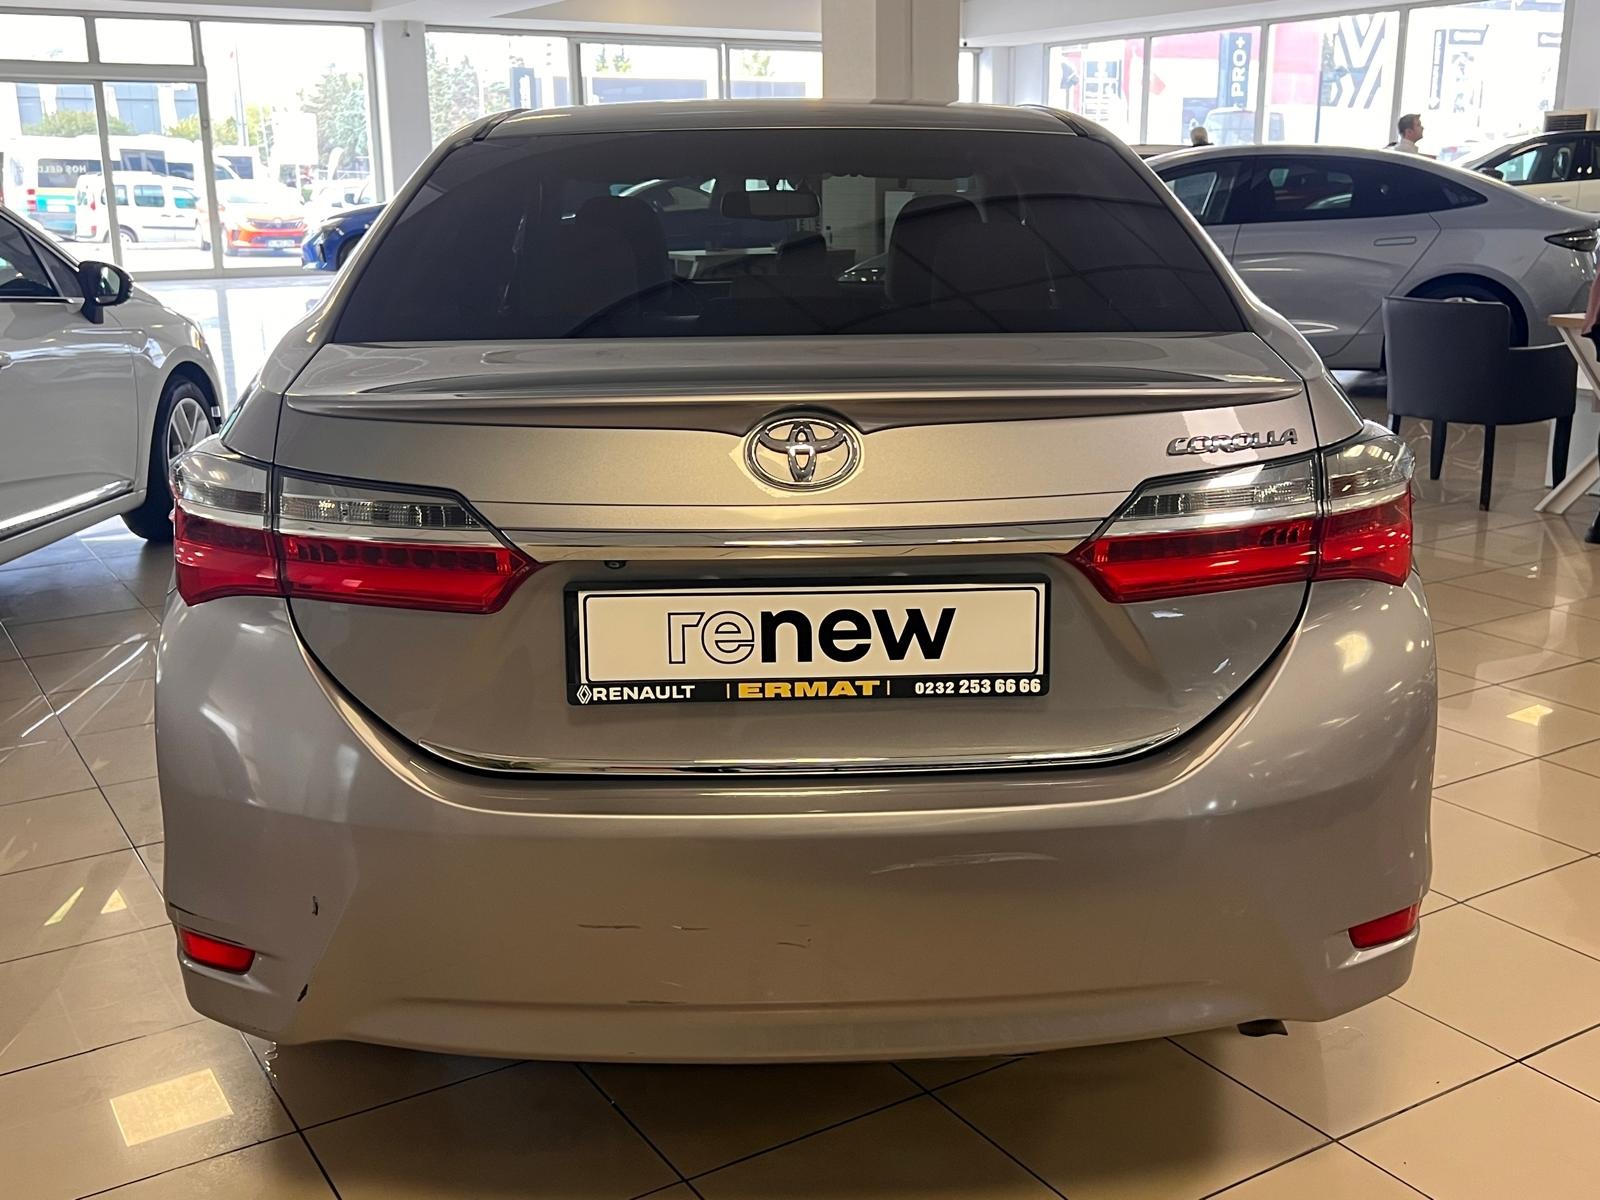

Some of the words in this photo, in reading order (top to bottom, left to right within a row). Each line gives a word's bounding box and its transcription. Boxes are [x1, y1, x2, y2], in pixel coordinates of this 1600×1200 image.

[1166, 427, 1299, 456] COROLLA
[667, 607, 957, 665] renew
[593, 685, 695, 702] RENAULT
[738, 680, 880, 699] ERMAT
[915, 682, 955, 695] 0232
[959, 679, 991, 694] 253
[994, 678, 1017, 693] 66
[1019, 678, 1041, 693] 66
